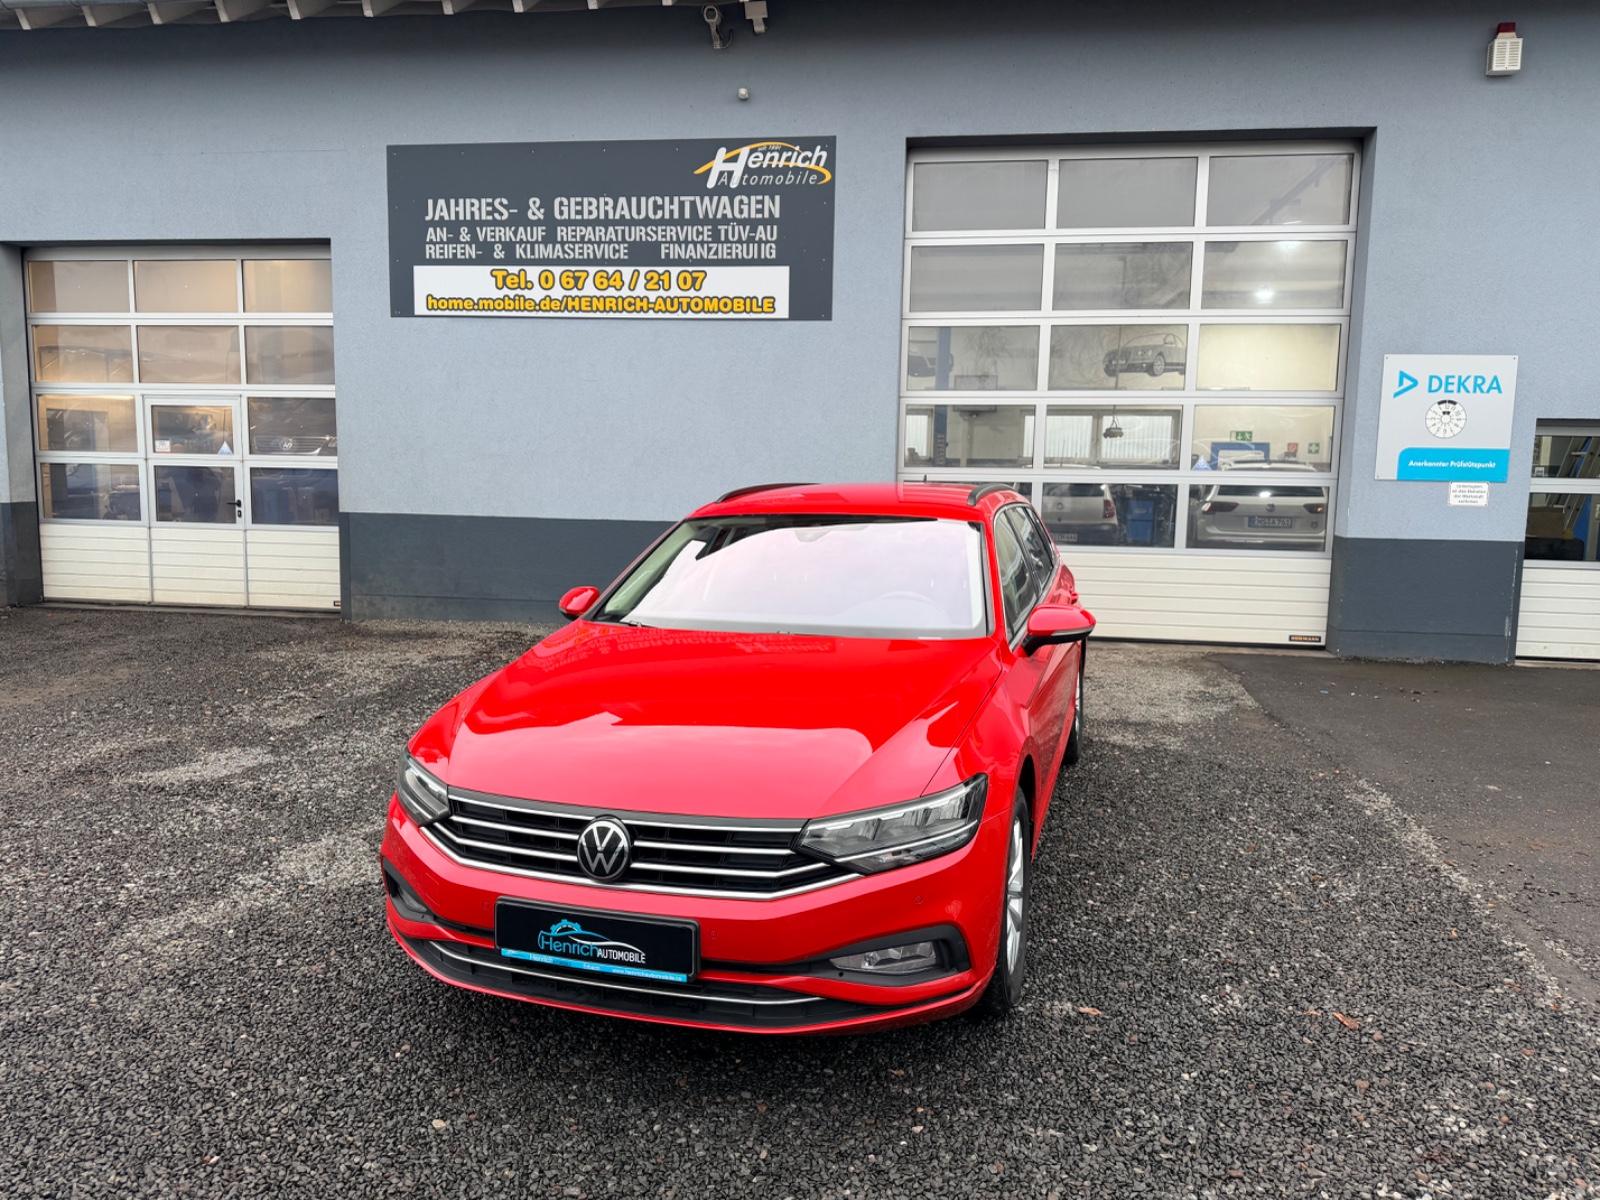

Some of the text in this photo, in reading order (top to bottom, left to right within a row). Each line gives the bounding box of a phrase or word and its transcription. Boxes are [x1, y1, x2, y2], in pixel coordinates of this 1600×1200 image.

[706, 145, 828, 189] Henrich
[717, 171, 818, 186] Atomobile
[425, 195, 780, 221] JAHRES- & GEBRAUCHTWAGEN
[426, 222, 778, 242] AN- & VERKAUF REPARATURSERVICE TÜV-AU
[425, 243, 483, 259] REIFEN-
[493, 243, 505, 259] &
[516, 243, 629, 259] KLIMASERVICE
[490, 269, 707, 291] Tel. 0 67 64 / 21 07
[426, 294, 776, 314] home.mobile.de/HENRICH-AUTOMOBILE
[1427, 375, 1503, 394] DEKRA
[541, 936, 600, 957] Henrich
[597, 948, 646, 964] AUTOMOBILE
